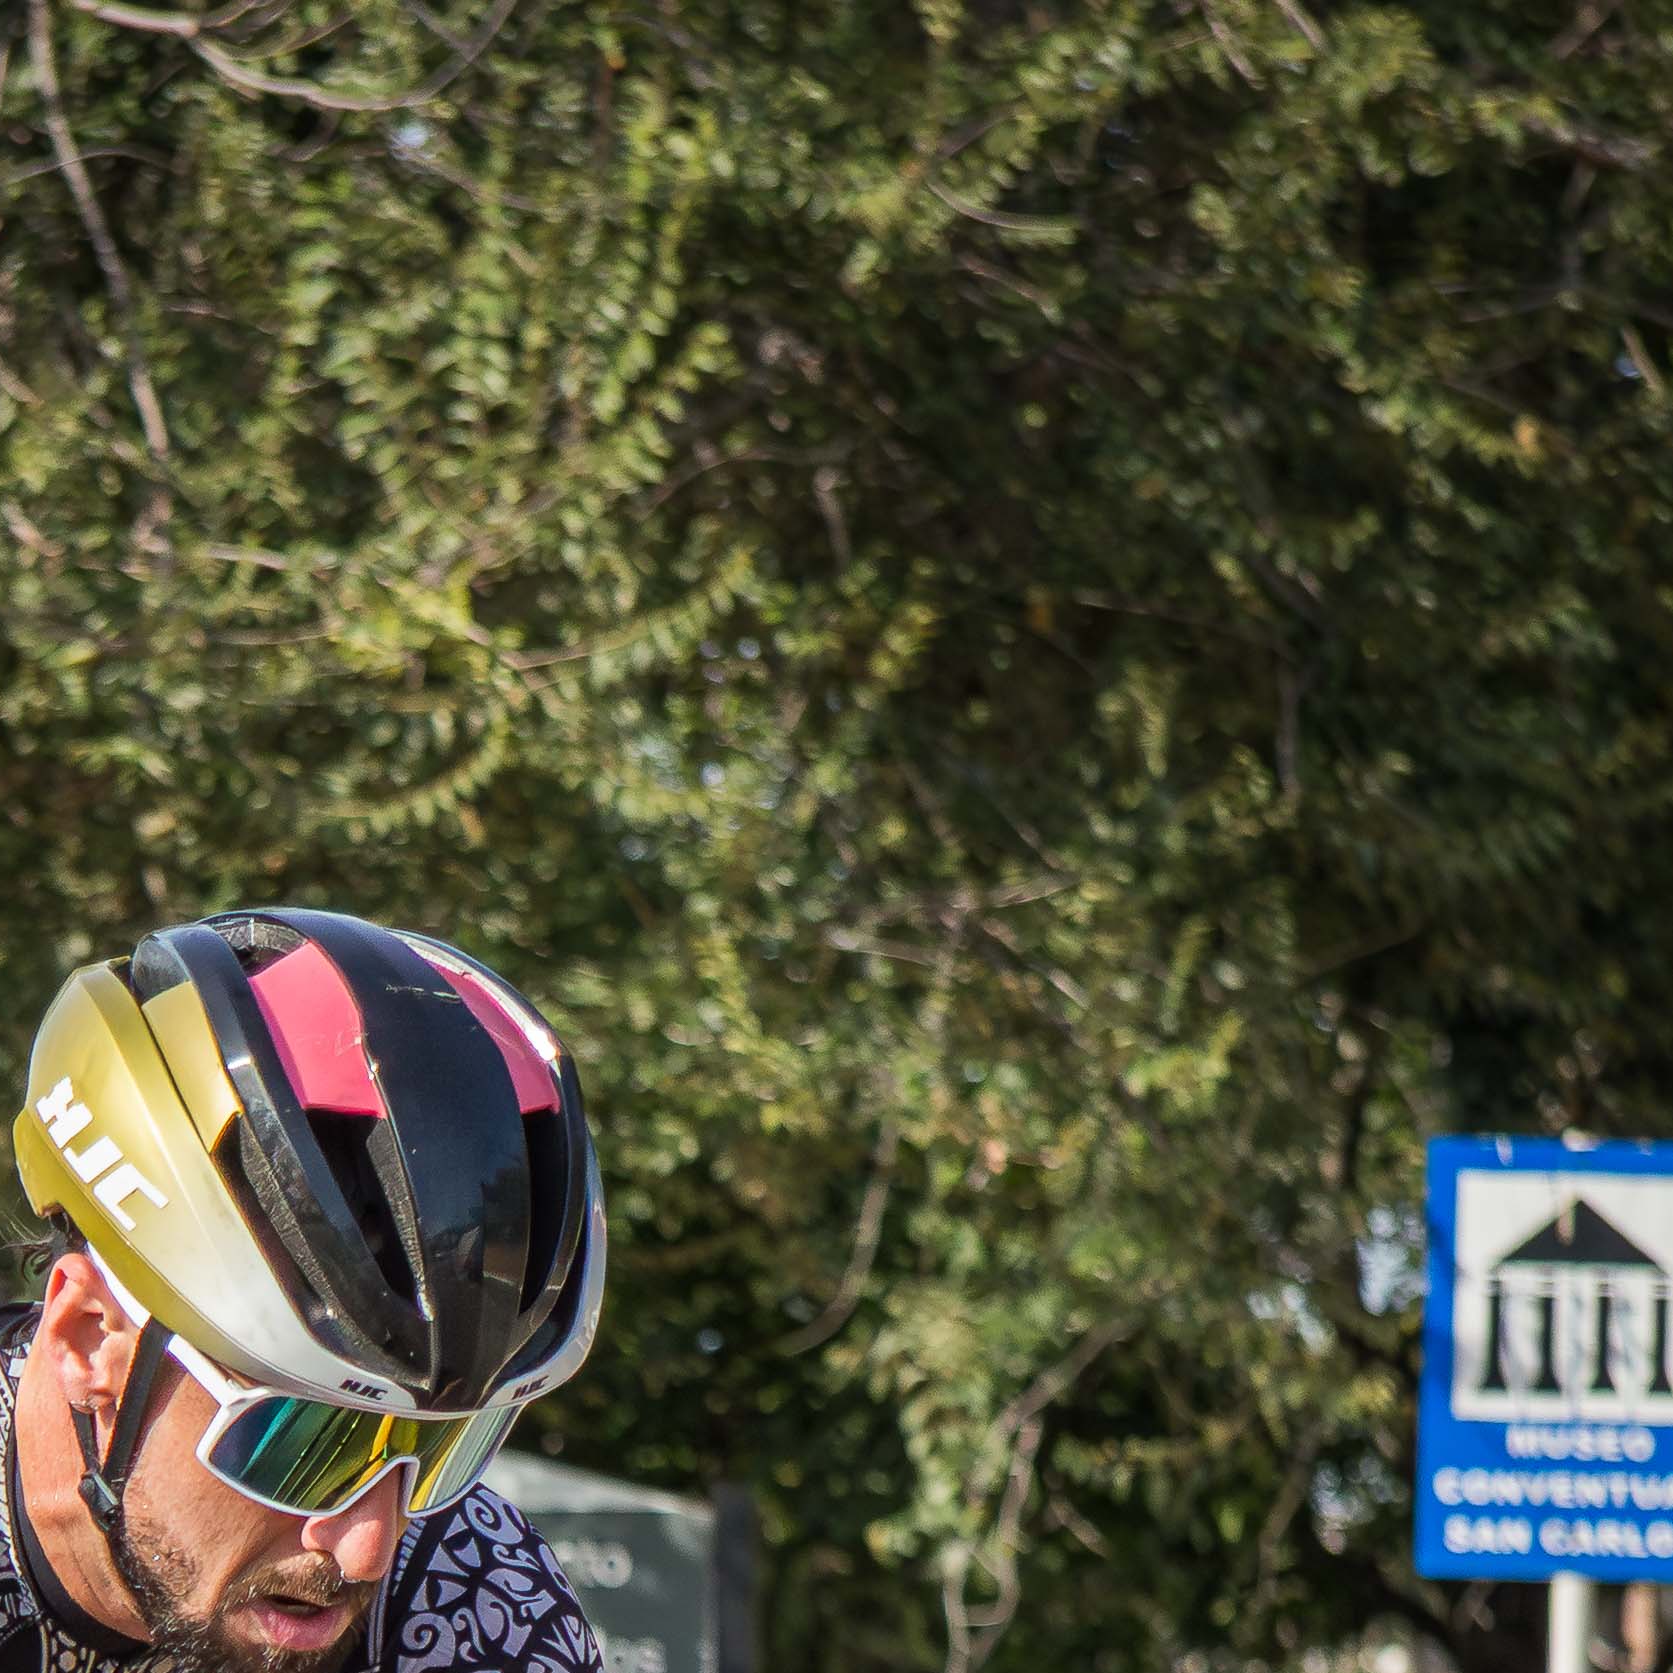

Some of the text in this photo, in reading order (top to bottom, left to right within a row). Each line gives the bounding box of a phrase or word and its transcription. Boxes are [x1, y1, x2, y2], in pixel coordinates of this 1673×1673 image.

[35, 1077, 169, 1232] HJC
[339, 1379, 388, 1400] HJC
[1505, 1424, 1656, 1462] MUSEO
[1444, 1514, 1533, 1555] SAN
